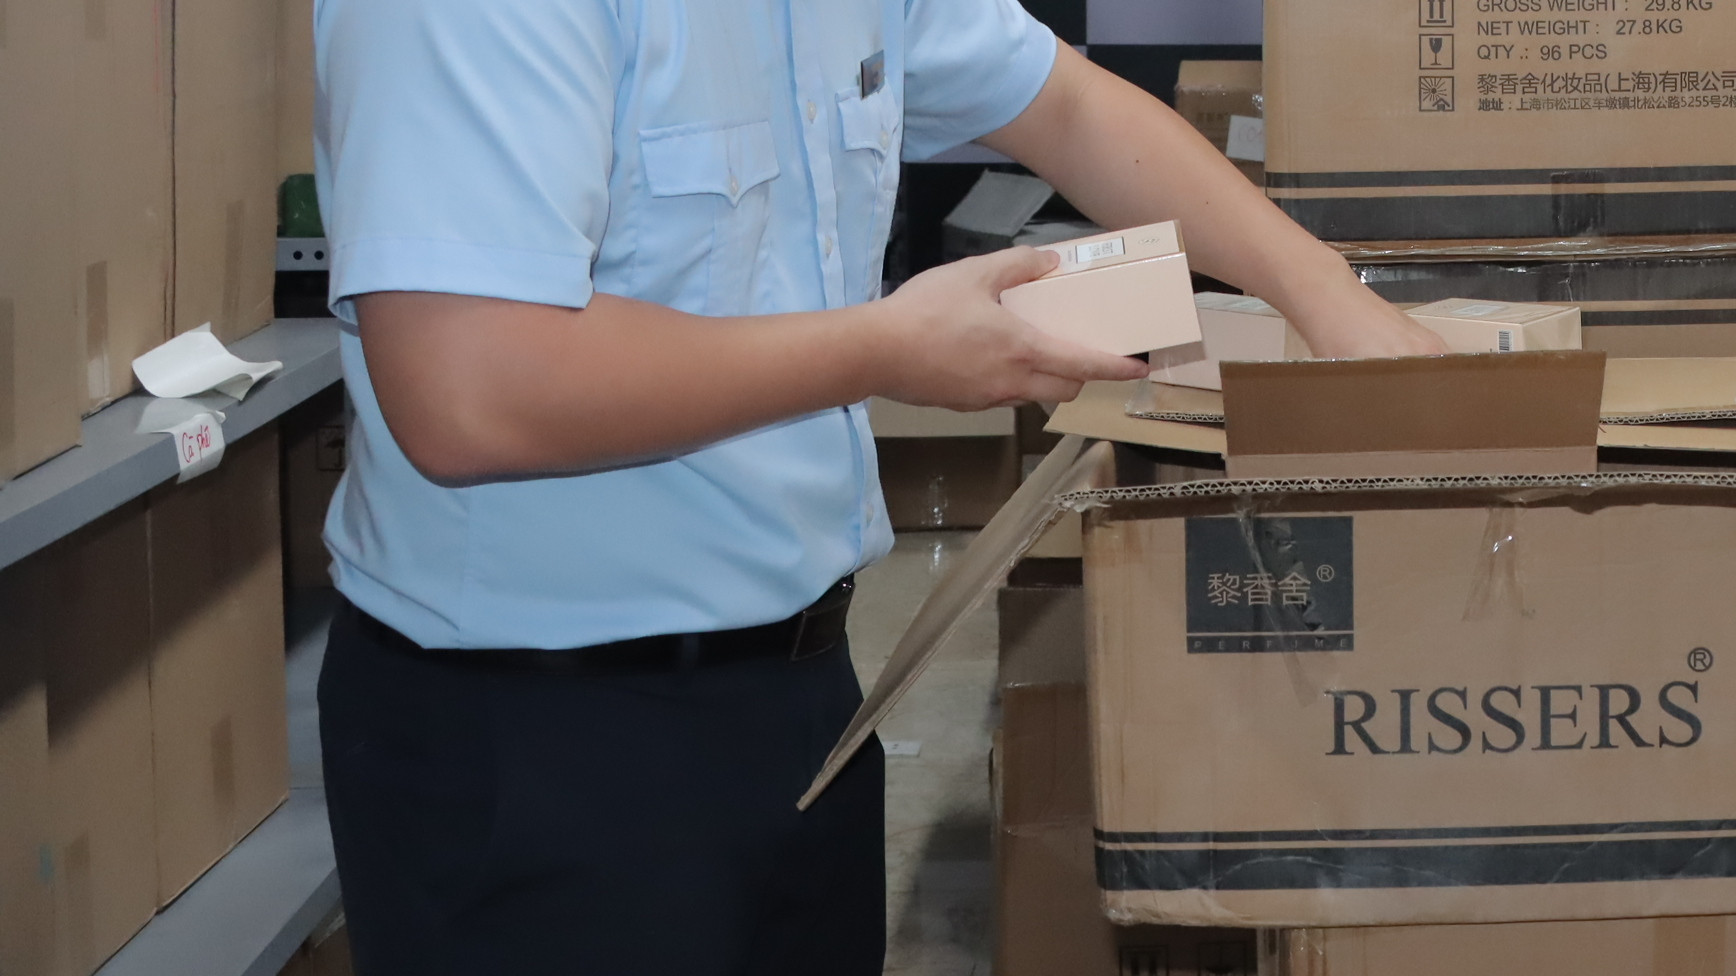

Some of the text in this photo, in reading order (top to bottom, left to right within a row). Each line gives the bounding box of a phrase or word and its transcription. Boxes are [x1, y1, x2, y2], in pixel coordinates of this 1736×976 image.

[1477, 21, 1512, 36] NET
[1540, 45, 1561, 61] 96
[1569, 44, 1608, 60] PCS
[1207, 571, 1311, 607] 黎香舍
[1324, 680, 1703, 757] RISSERS
